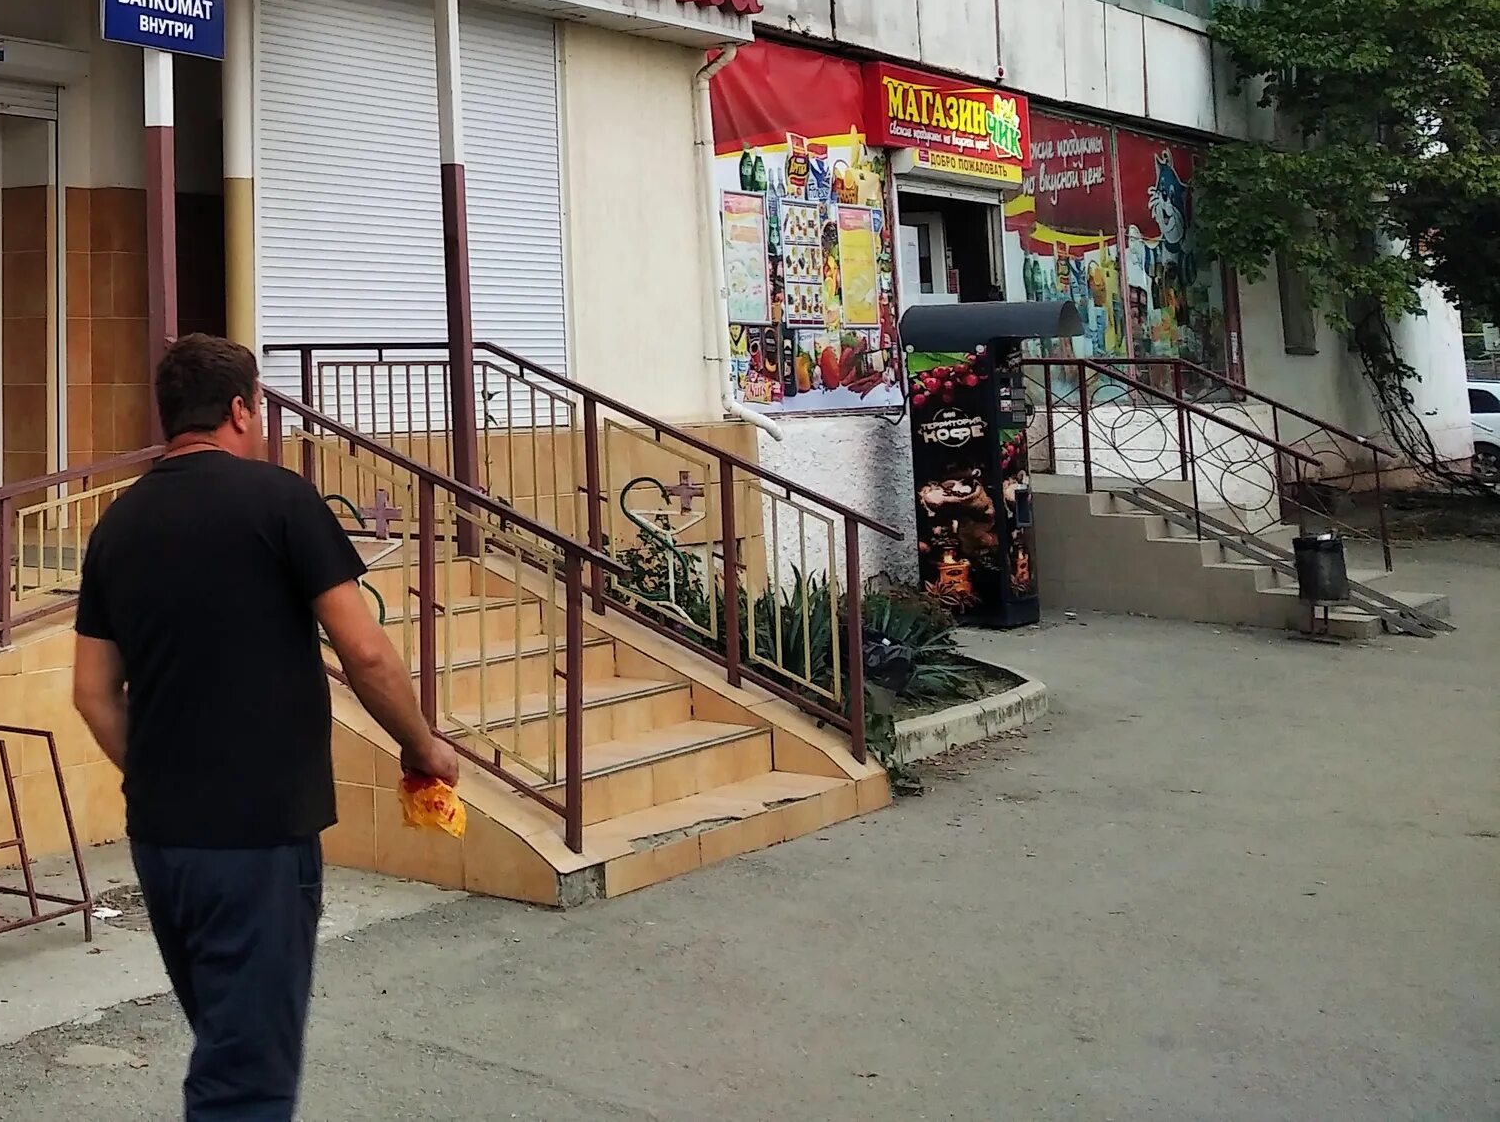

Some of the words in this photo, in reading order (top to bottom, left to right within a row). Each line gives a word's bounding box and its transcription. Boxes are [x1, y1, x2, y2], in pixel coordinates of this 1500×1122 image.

[139, 14, 194, 40] ВНУТРИ
[930, 153, 956, 169] ДОБРО
[958, 158, 1008, 177] ПОЖАЛОВАТЬ
[921, 416, 982, 431] ТЕРРИТОРИЯ
[923, 425, 985, 444] КОФЕ
